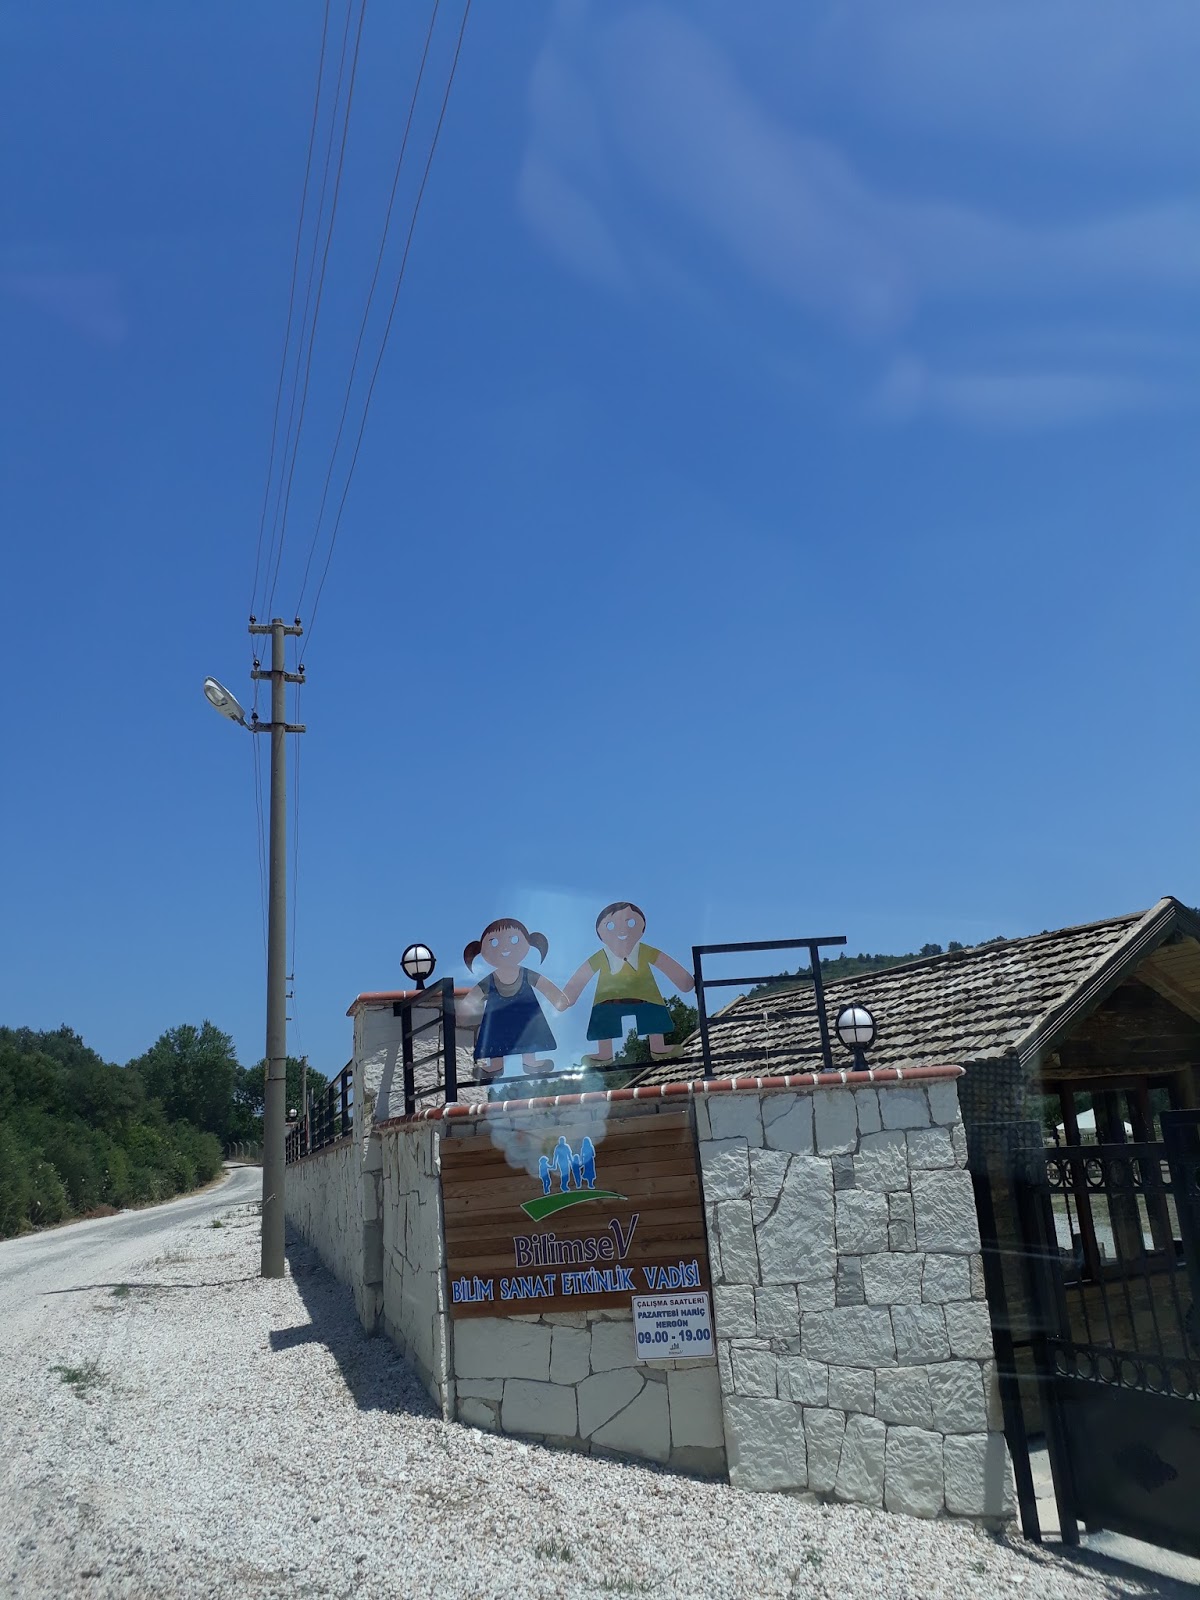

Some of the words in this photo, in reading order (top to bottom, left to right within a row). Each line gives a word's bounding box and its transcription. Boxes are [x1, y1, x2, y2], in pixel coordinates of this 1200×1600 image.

[513, 1213, 639, 1268] BilimseV
[452, 1276, 494, 1303] BİLİM
[500, 1274, 556, 1300] SANAT
[561, 1265, 637, 1295] ETKİNLİK
[642, 1260, 701, 1290] VADİSİ
[637, 1300, 668, 1309] ÇALIŞMA
[670, 1296, 705, 1306] SAATLERİ
[638, 1309, 679, 1319] PAZARTESİ
[681, 1307, 705, 1317] HARİÇ
[656, 1319, 689, 1328] HERGÜN
[638, 1331, 669, 1344] 09.00
[679, 1328, 711, 1341] 19.00
